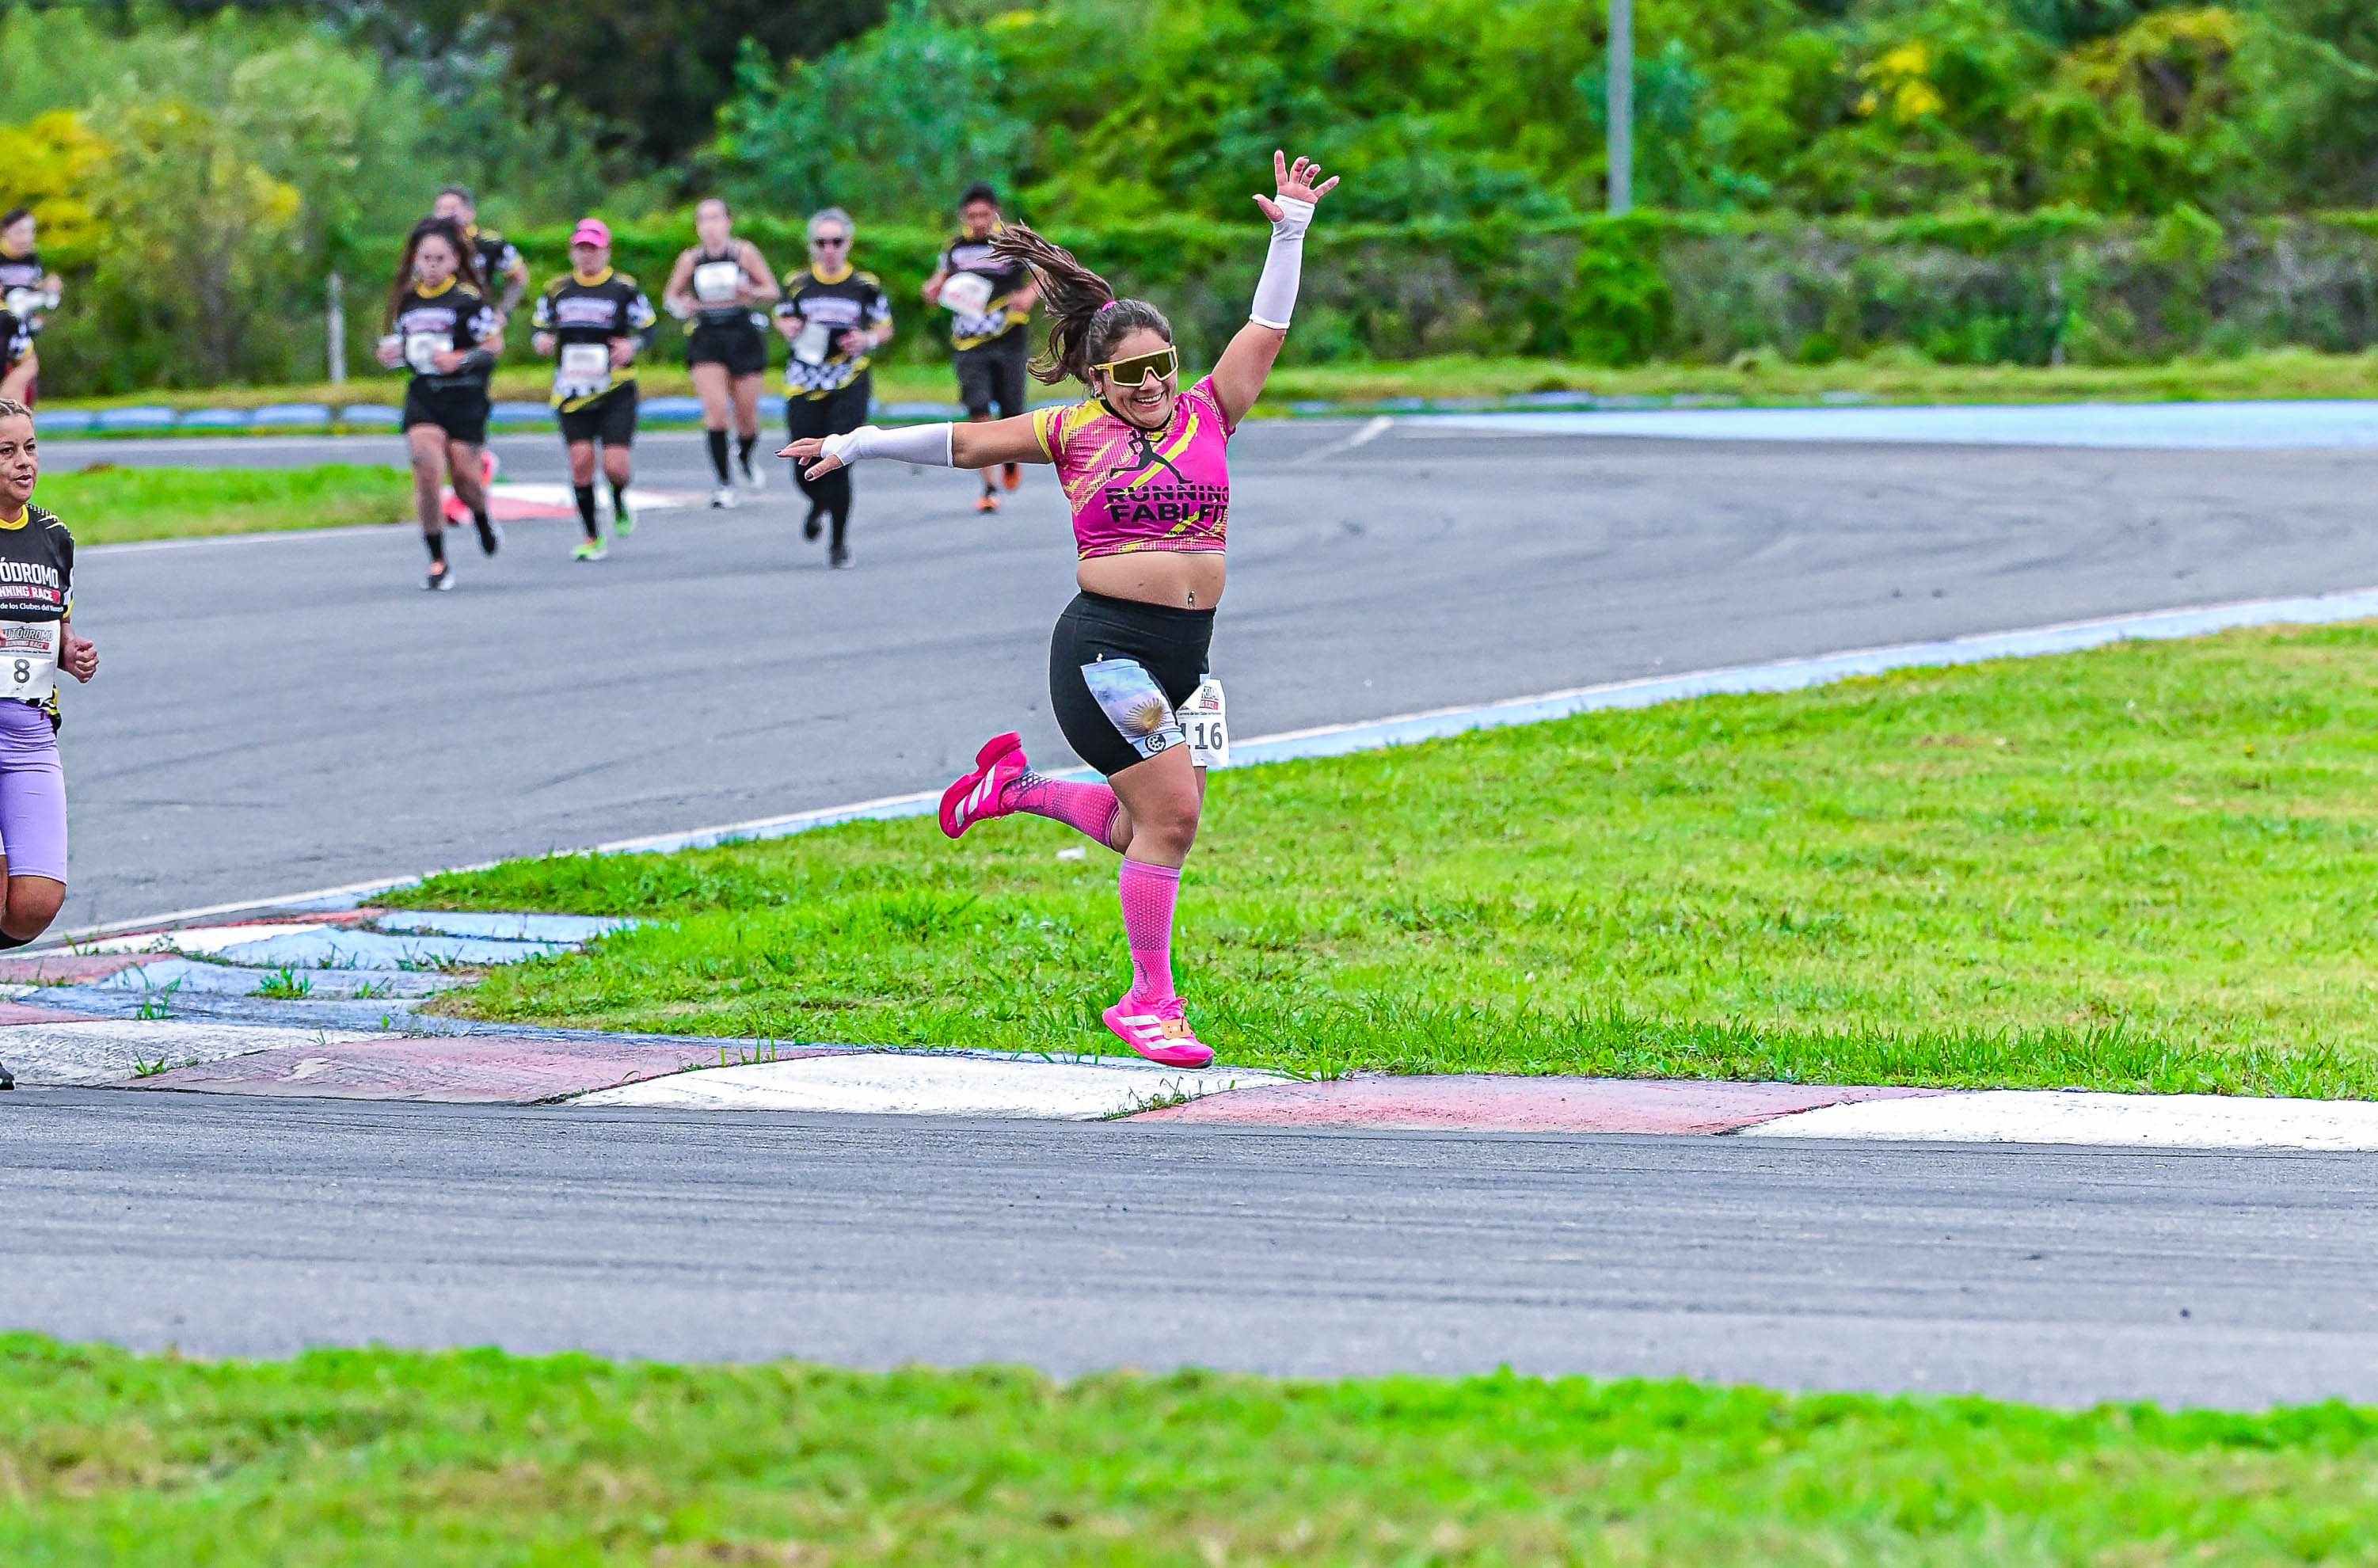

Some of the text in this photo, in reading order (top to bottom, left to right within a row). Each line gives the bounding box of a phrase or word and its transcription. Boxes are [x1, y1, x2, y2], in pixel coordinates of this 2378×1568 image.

[1109, 502, 1228, 523] FABI FIT
[31, 586, 54, 602] RACE
[5, 626, 53, 641] UTÓDROMO
[13, 658, 30, 683] 8
[1179, 722, 1223, 750] 116
